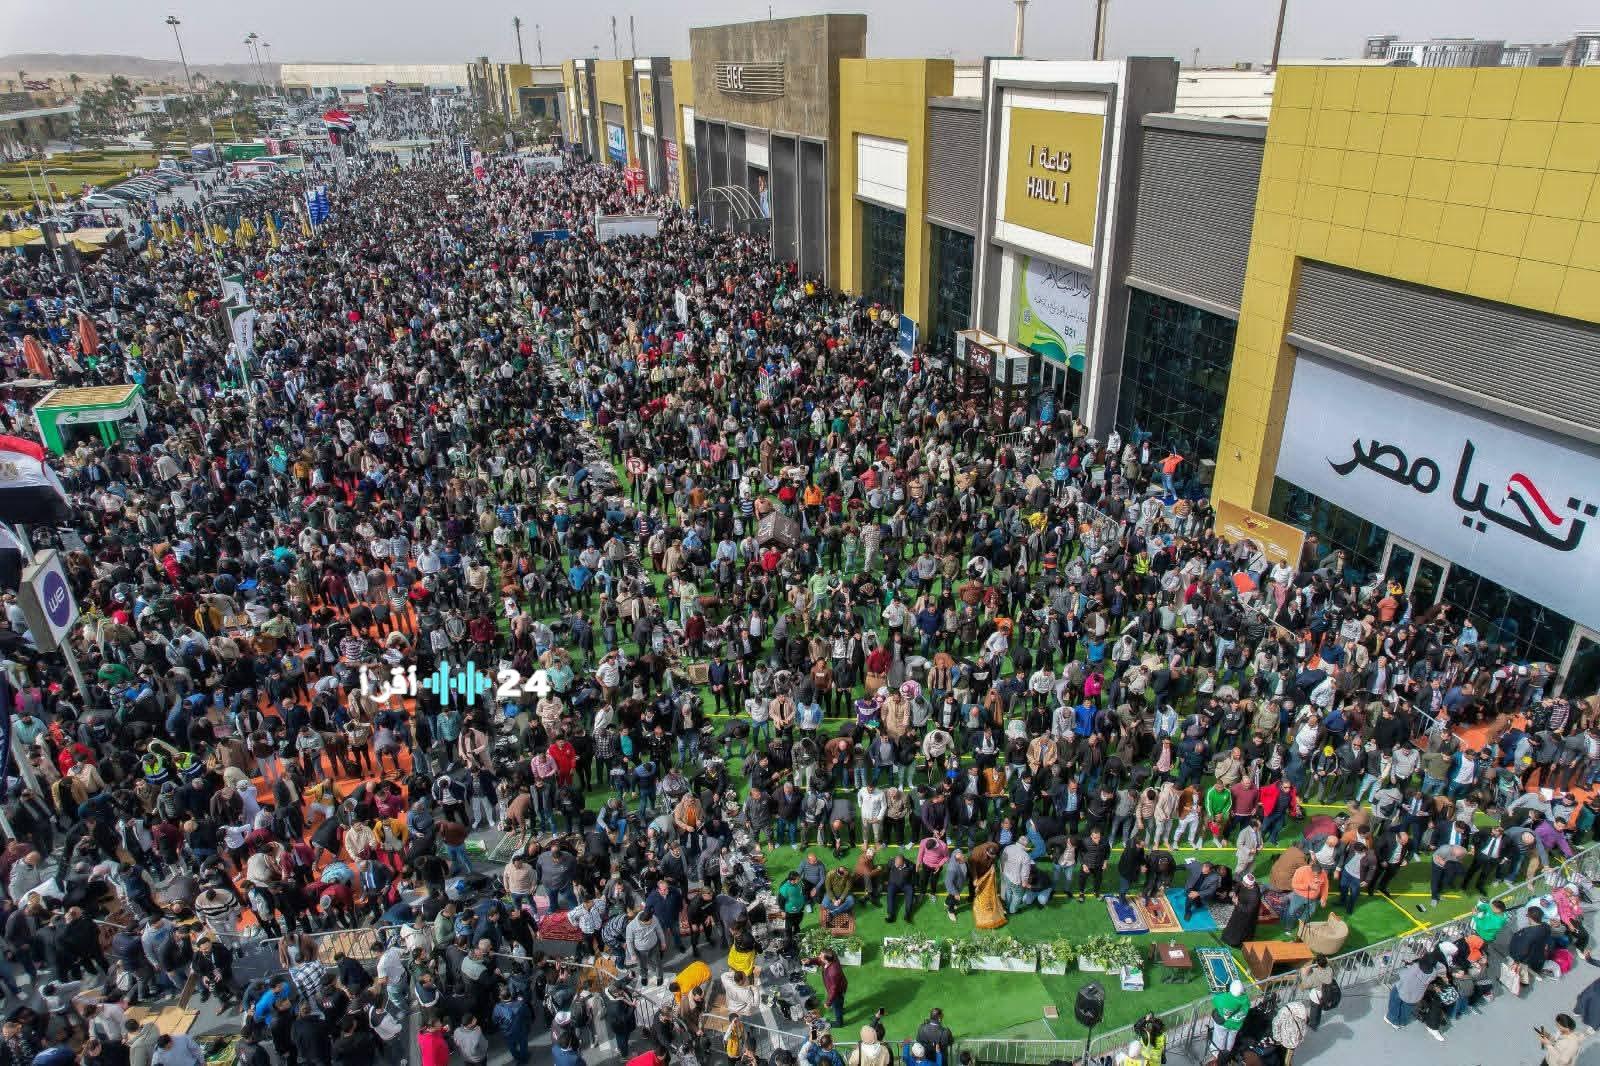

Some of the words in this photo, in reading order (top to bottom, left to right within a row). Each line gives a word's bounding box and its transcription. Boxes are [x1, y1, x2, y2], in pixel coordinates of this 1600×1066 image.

[1039, 147, 1071, 173] قاعة
[1027, 176, 1058, 204] HALL
[1063, 182, 1070, 205] 1
[1326, 438, 1441, 494] مصر
[1452, 439, 1599, 551] تحيا
